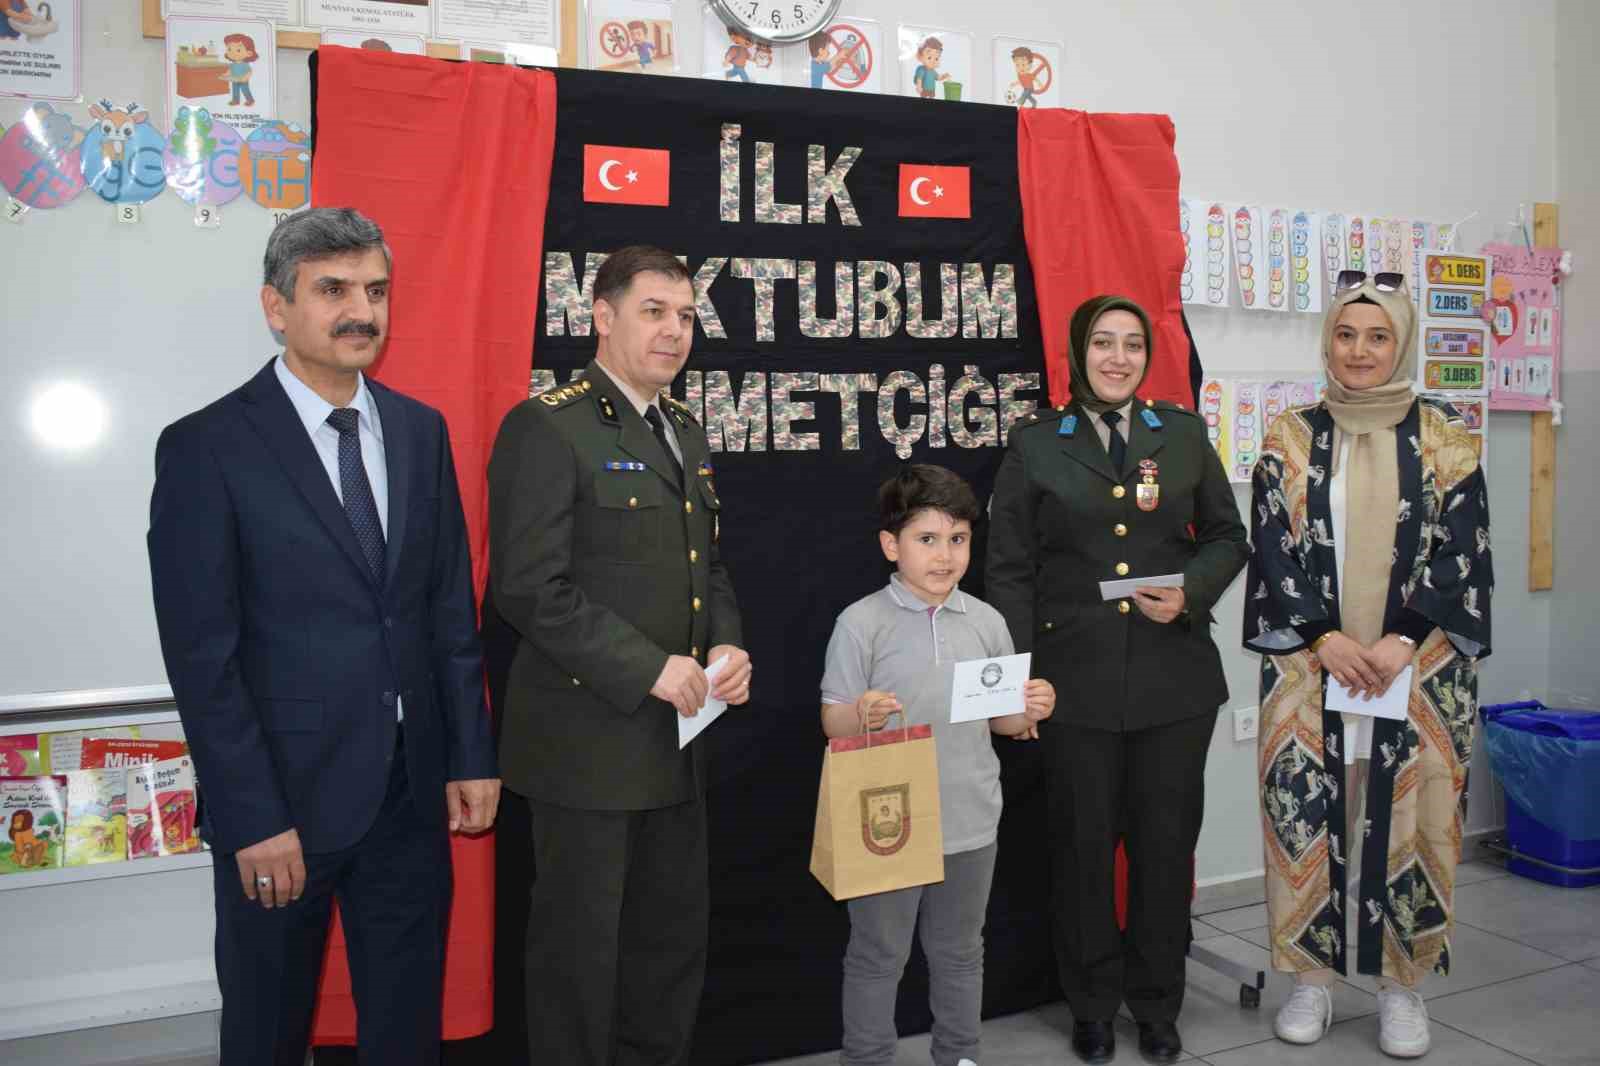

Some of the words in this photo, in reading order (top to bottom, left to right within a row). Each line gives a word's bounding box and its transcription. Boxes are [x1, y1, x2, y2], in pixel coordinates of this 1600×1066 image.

[749, 2, 759, 15] 7
[794, 5, 803, 19] 5
[771, 10, 781, 24] 6
[720, 122, 863, 227] İLK
[123, 207, 133, 219] 8
[201, 209, 210, 222] 9
[1456, 263, 1481, 279] DERS
[545, 251, 1018, 342] MKTUBUM
[528, 363, 1040, 460] METÇİĞE
